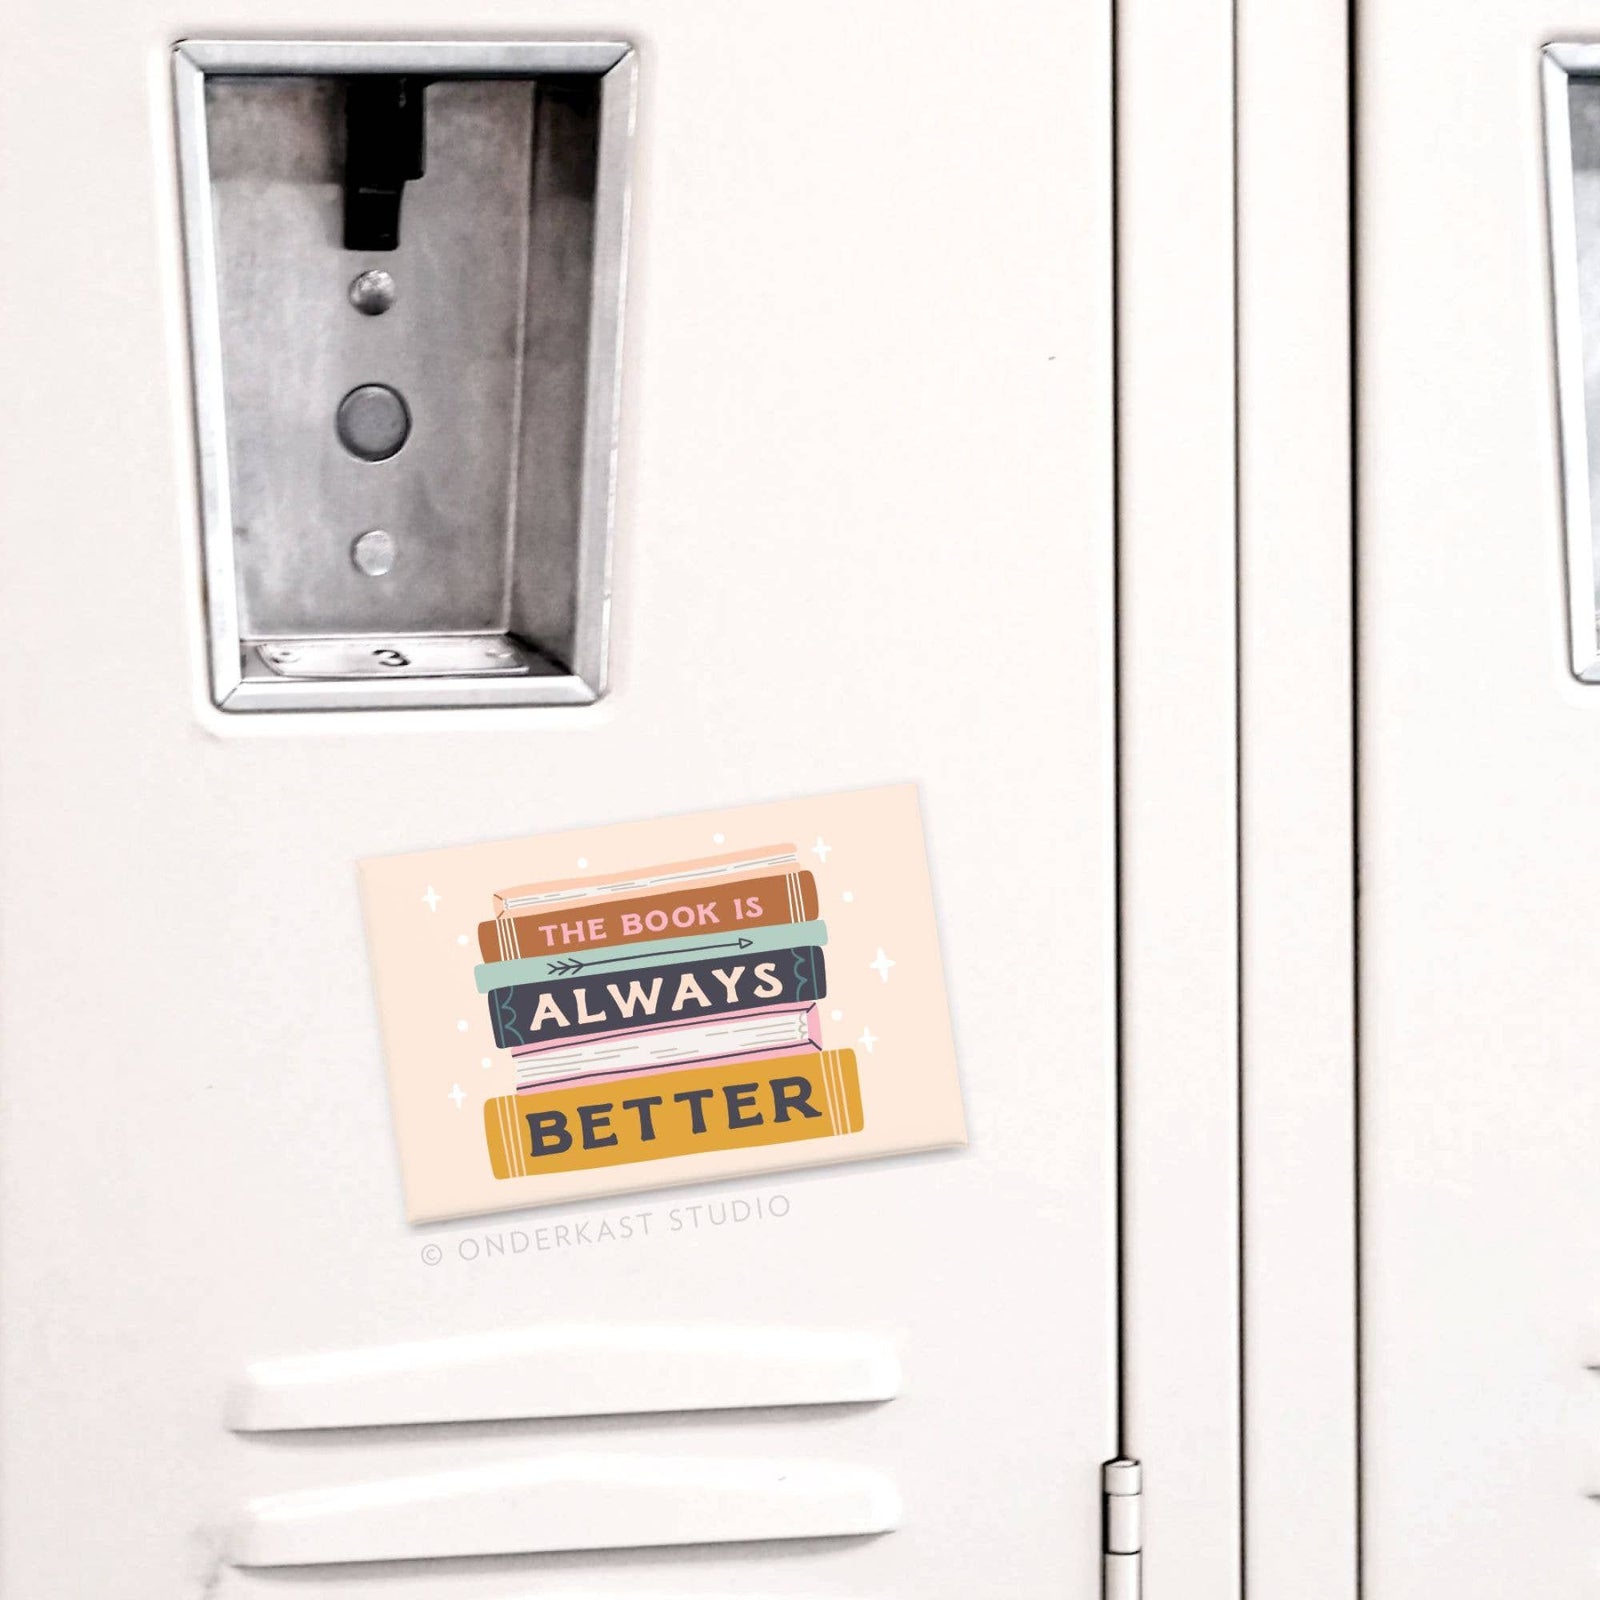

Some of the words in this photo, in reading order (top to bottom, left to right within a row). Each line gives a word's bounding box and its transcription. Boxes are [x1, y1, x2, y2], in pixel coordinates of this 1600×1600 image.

[538, 917, 608, 948] THE
[621, 901, 719, 936] BOOK
[733, 896, 765, 921] IS
[529, 962, 784, 1031] ALWAYS
[524, 1075, 823, 1158] BETTER
